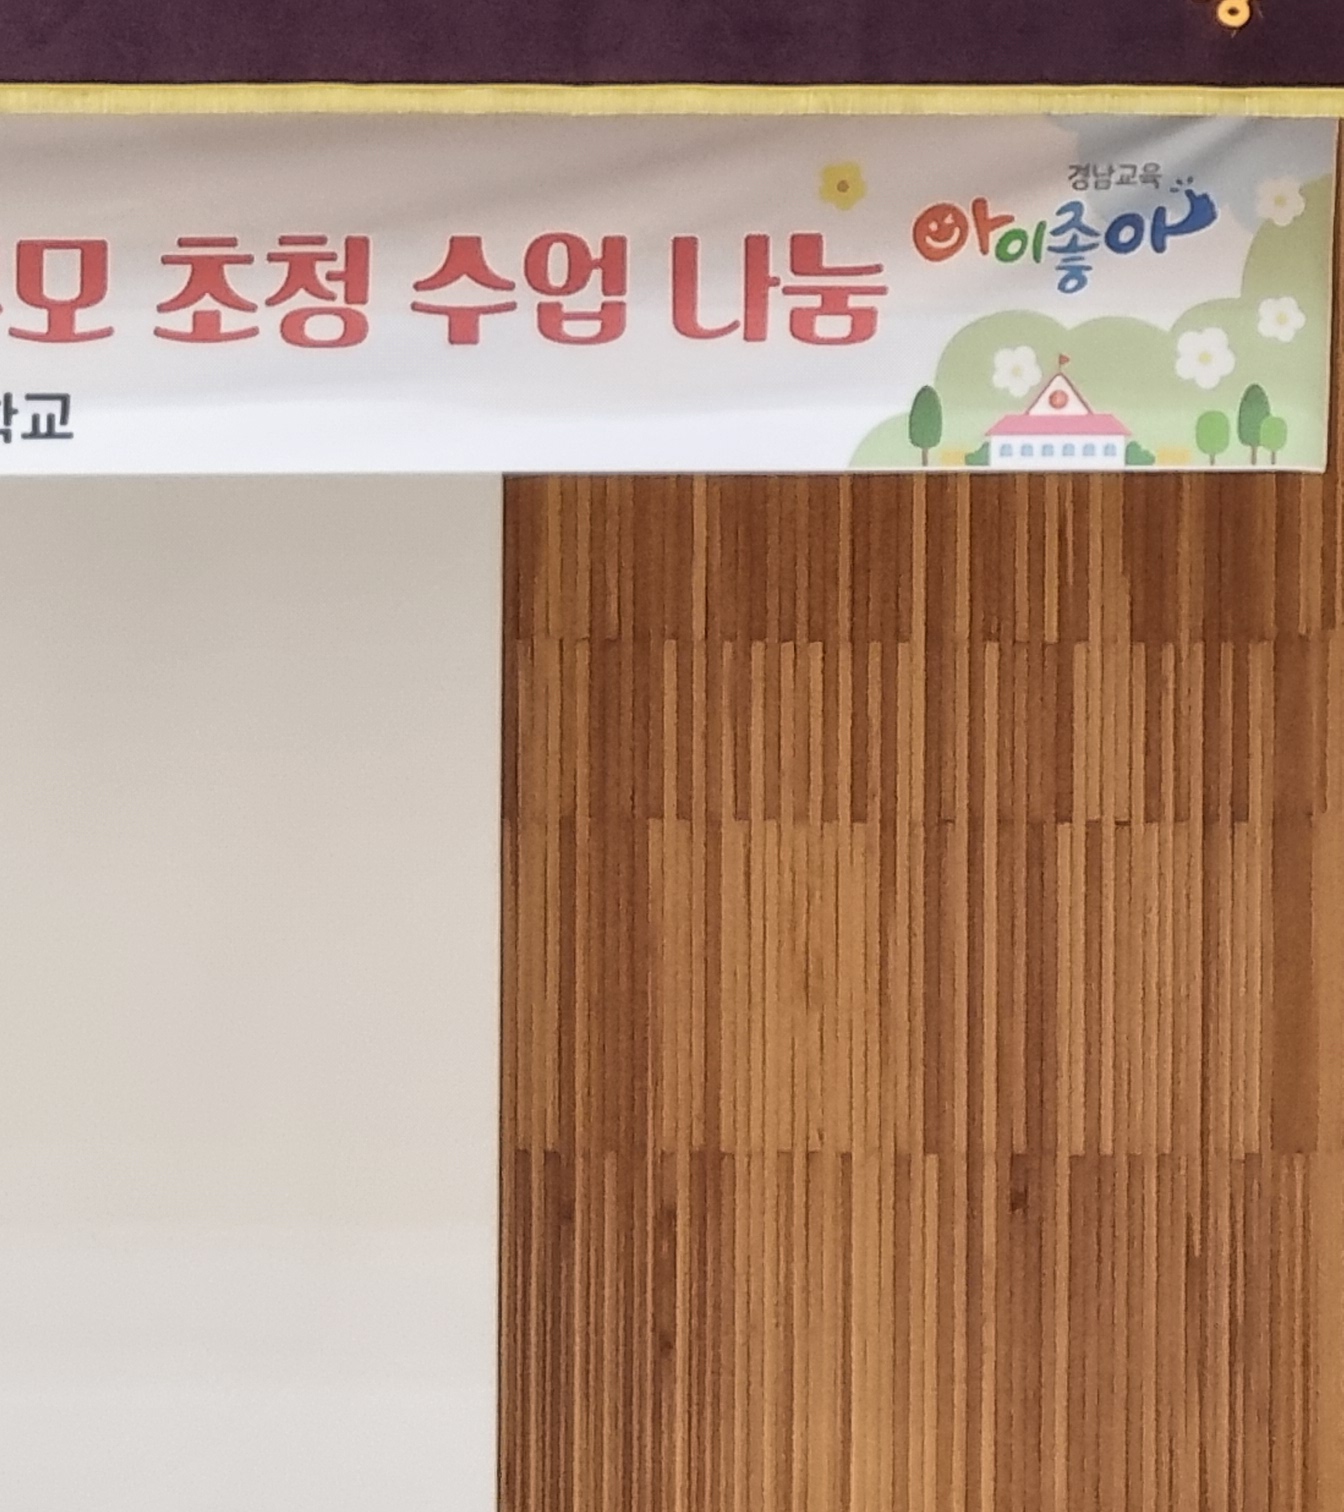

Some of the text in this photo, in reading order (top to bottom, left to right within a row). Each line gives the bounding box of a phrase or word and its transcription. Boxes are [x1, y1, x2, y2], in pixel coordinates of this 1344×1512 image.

[1067, 162, 1163, 191] 경남교육
[153, 235, 372, 348] 초청
[411, 231, 628, 346] 수업
[670, 232, 889, 346] 나눔
[912, 188, 1219, 295] 아이좋아
